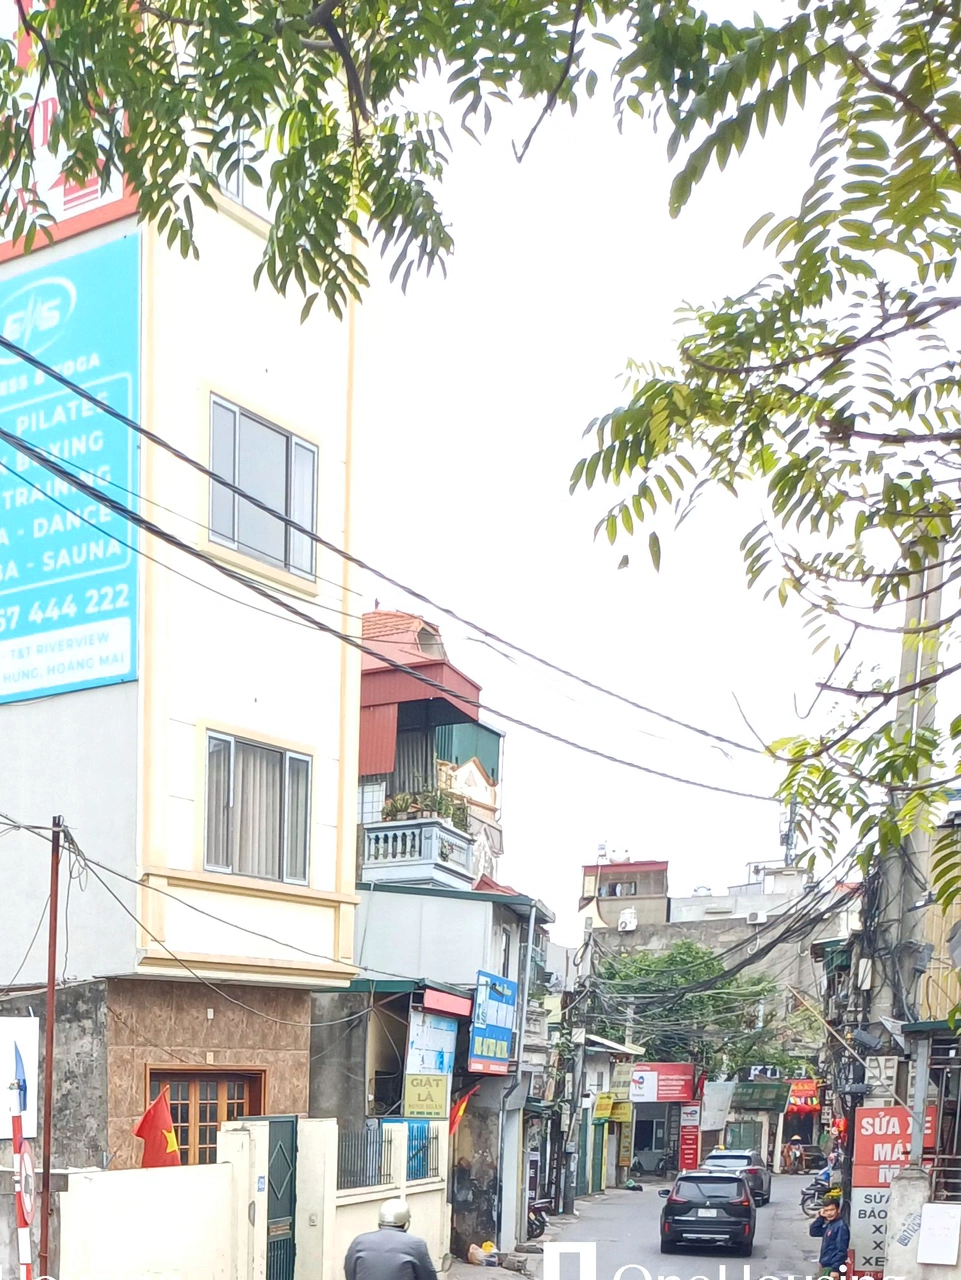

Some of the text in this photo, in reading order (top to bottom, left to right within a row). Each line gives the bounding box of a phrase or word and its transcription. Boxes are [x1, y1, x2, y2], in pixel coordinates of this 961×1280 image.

[33, 503, 113, 539] DANCE
[43, 538, 122, 572] SAUNA
[28, 594, 78, 624] 444
[85, 583, 130, 615] 222
[10, 646, 32, 661] T&T
[37, 632, 110, 655] RIVERVIEW
[99, 652, 125, 667] MAI
[860, 1111, 901, 1136] SỬA
